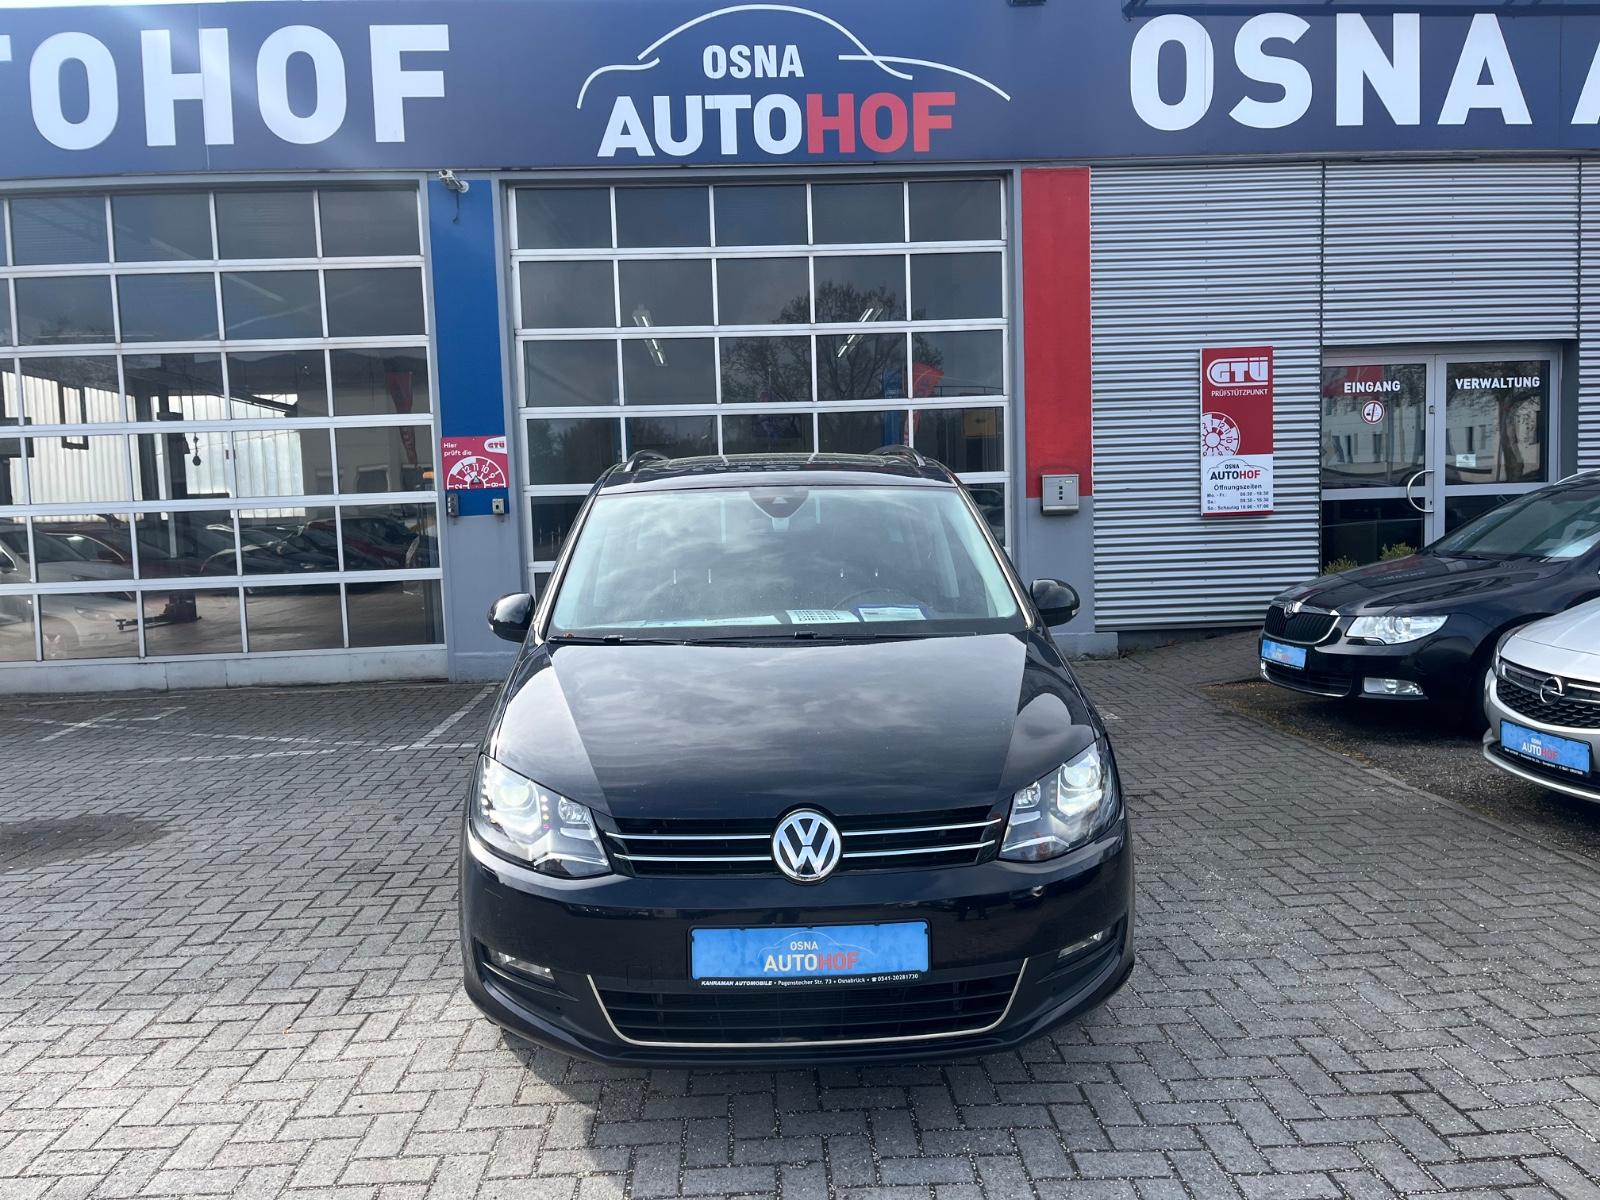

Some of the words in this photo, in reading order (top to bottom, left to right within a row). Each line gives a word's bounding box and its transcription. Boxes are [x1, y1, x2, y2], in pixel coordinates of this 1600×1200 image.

[703, 44, 805, 79] OSNA
[1130, 12, 1533, 131] OSNA
[0, 24, 449, 151] OHOF
[597, 91, 956, 158] AUTOHOF
[1210, 356, 1268, 383] GTÜ
[1344, 380, 1401, 393] EINGANG
[1455, 376, 1541, 390] VERWALTUNG
[1211, 388, 1268, 397] PRÜFSTÜTZPUNKT
[462, 465, 472, 475] 12
[472, 463, 479, 472] 11
[481, 464, 489, 474] 10
[1210, 470, 1261, 480] AUTOHOF
[1213, 483, 1262, 491] Öffnungszeiten
[1521, 742, 1558, 760] AUTOHOF
[790, 941, 819, 951] OSNA
[763, 952, 859, 972] AUTOHOF
